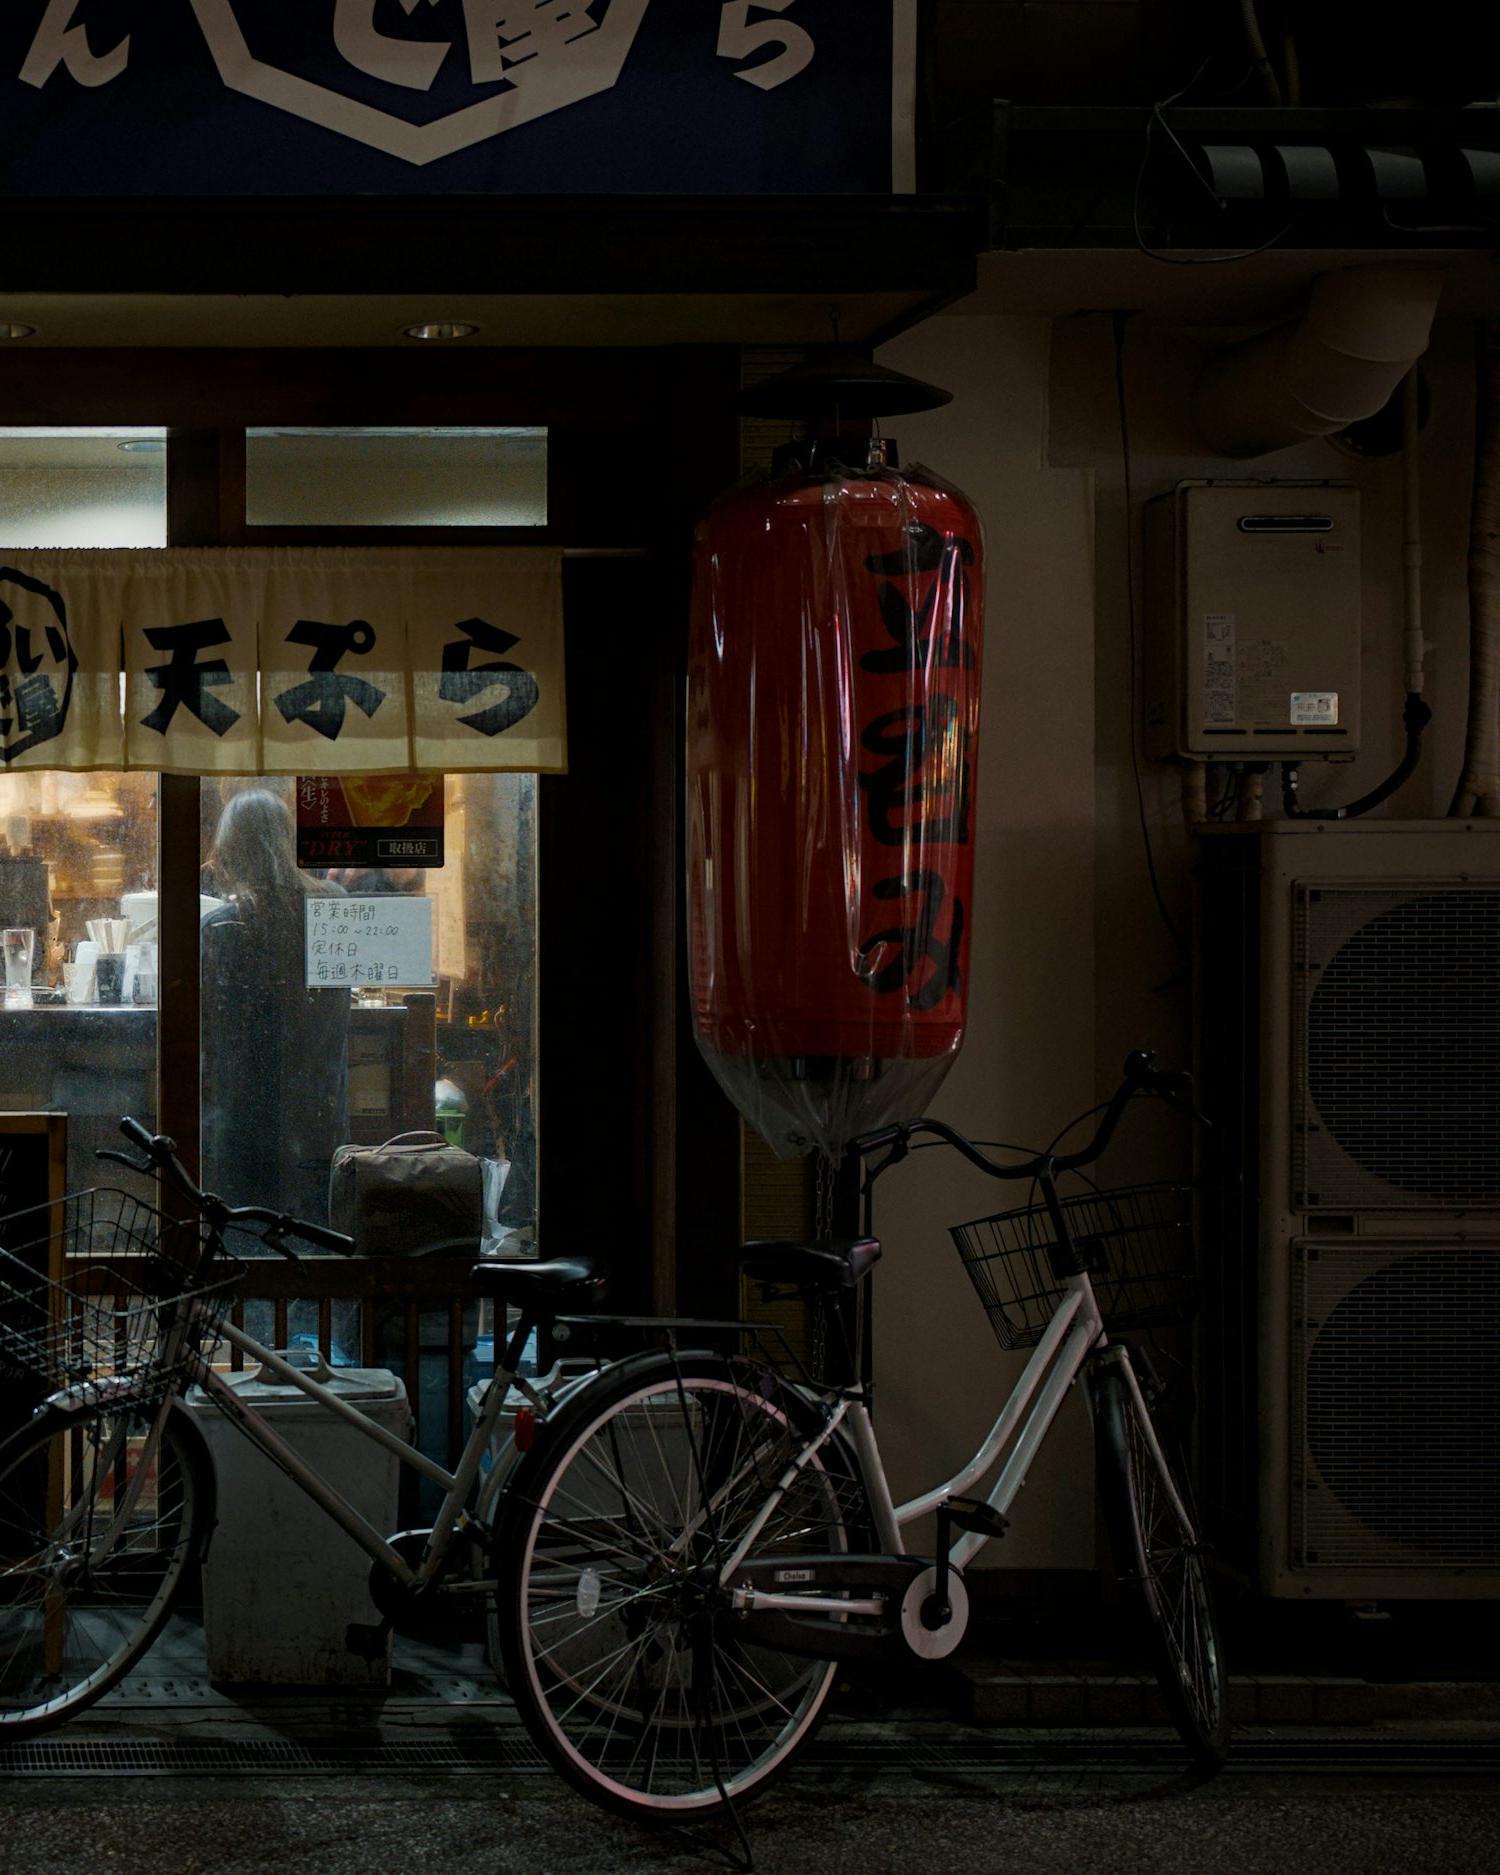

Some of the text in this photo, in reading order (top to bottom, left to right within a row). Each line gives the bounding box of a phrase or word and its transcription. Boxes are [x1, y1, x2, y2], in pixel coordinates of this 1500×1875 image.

[139, 617, 540, 741] 天ぷら
[388, 841, 428, 855] 取扱店
[310, 901, 377, 921] 営業時間
[311, 940, 358, 957] 定休日
[316, 961, 399, 981] 毎週木曜日
